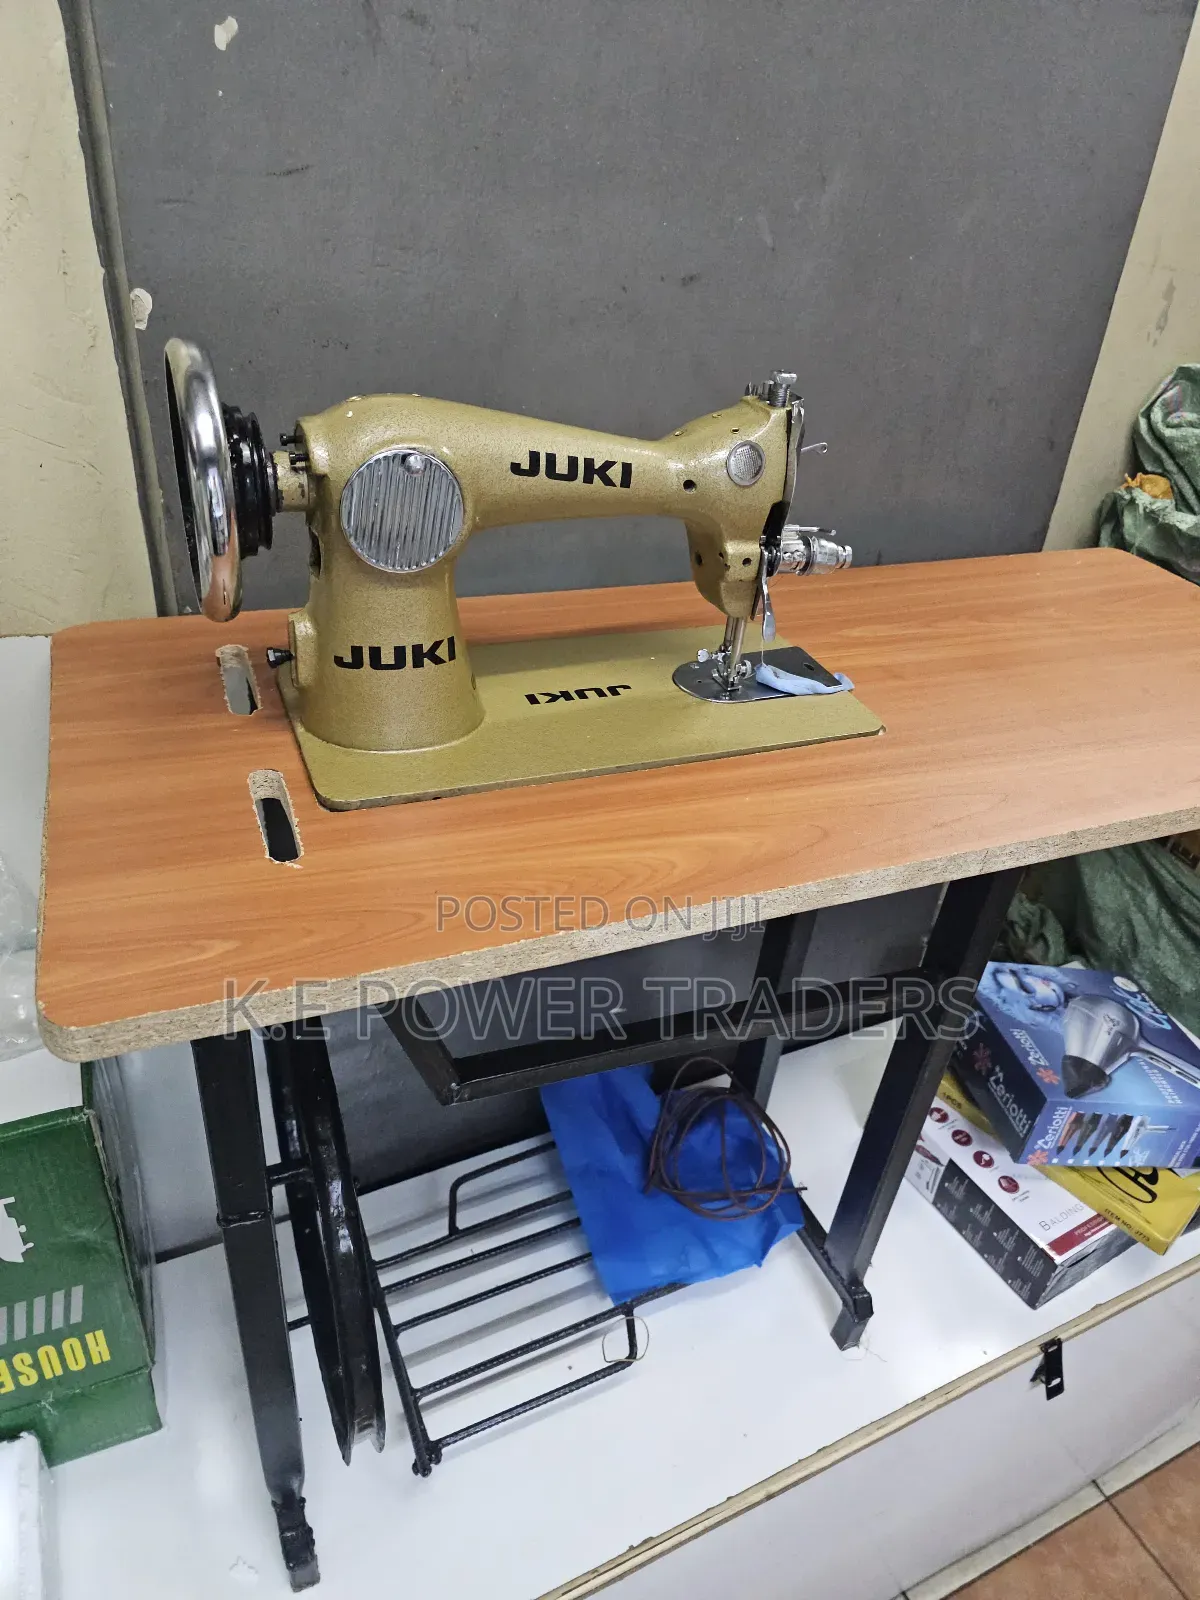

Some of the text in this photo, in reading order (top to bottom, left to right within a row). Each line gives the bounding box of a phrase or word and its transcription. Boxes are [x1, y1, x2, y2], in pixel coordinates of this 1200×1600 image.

[511, 450, 633, 489] JUKI
[334, 635, 457, 671] JUKI
[525, 685, 633, 705] JUKI
[1038, 1203, 1085, 1232] BALDING
